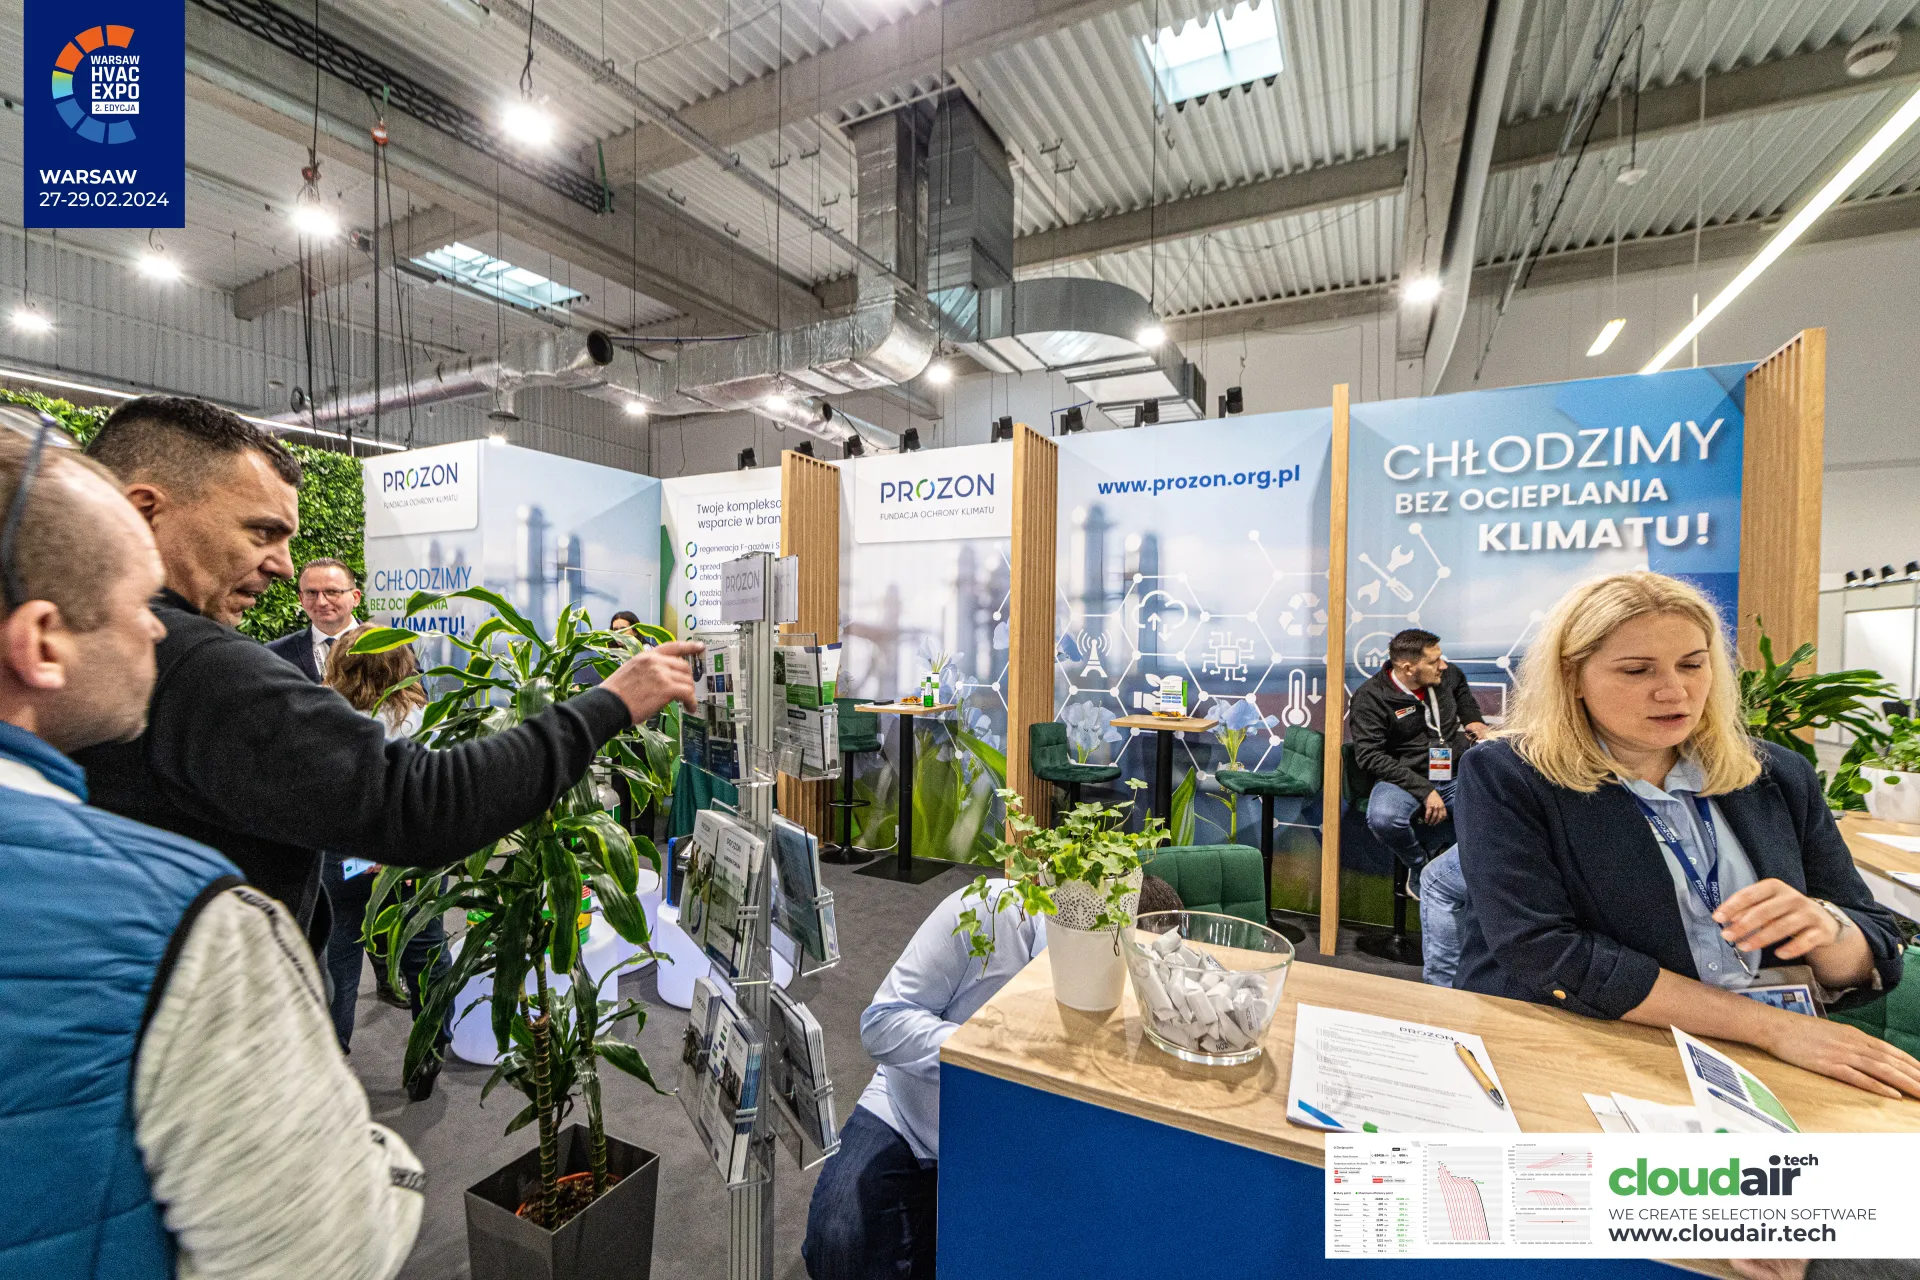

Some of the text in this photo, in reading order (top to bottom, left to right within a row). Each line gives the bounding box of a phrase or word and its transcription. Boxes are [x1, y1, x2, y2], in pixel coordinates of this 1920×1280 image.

[1383, 418, 1725, 481] CHŁODZIMY
[383, 462, 458, 493] PROZON
[880, 473, 995, 503] PROZON
[1097, 464, 1301, 496] www.prozon.org.pl
[696, 502, 724, 516] Twoje
[1395, 478, 1669, 515] BEZ OCIEPLANIA
[697, 516, 743, 531] wsparcie
[745, 518, 754, 526] w
[880, 506, 995, 521] FUNDACJA OCHRONY KLIMATU
[1478, 512, 1709, 552] KLIMATU!
[699, 543, 739, 555] regeneracja
[374, 566, 472, 591] CHŁODZIMY
[725, 570, 760, 593] PROZON
[370, 597, 449, 611] BEZ OCINIA
[1652, 815, 1677, 843] PROZON
[1399, 1026, 1454, 1041] PROZON
